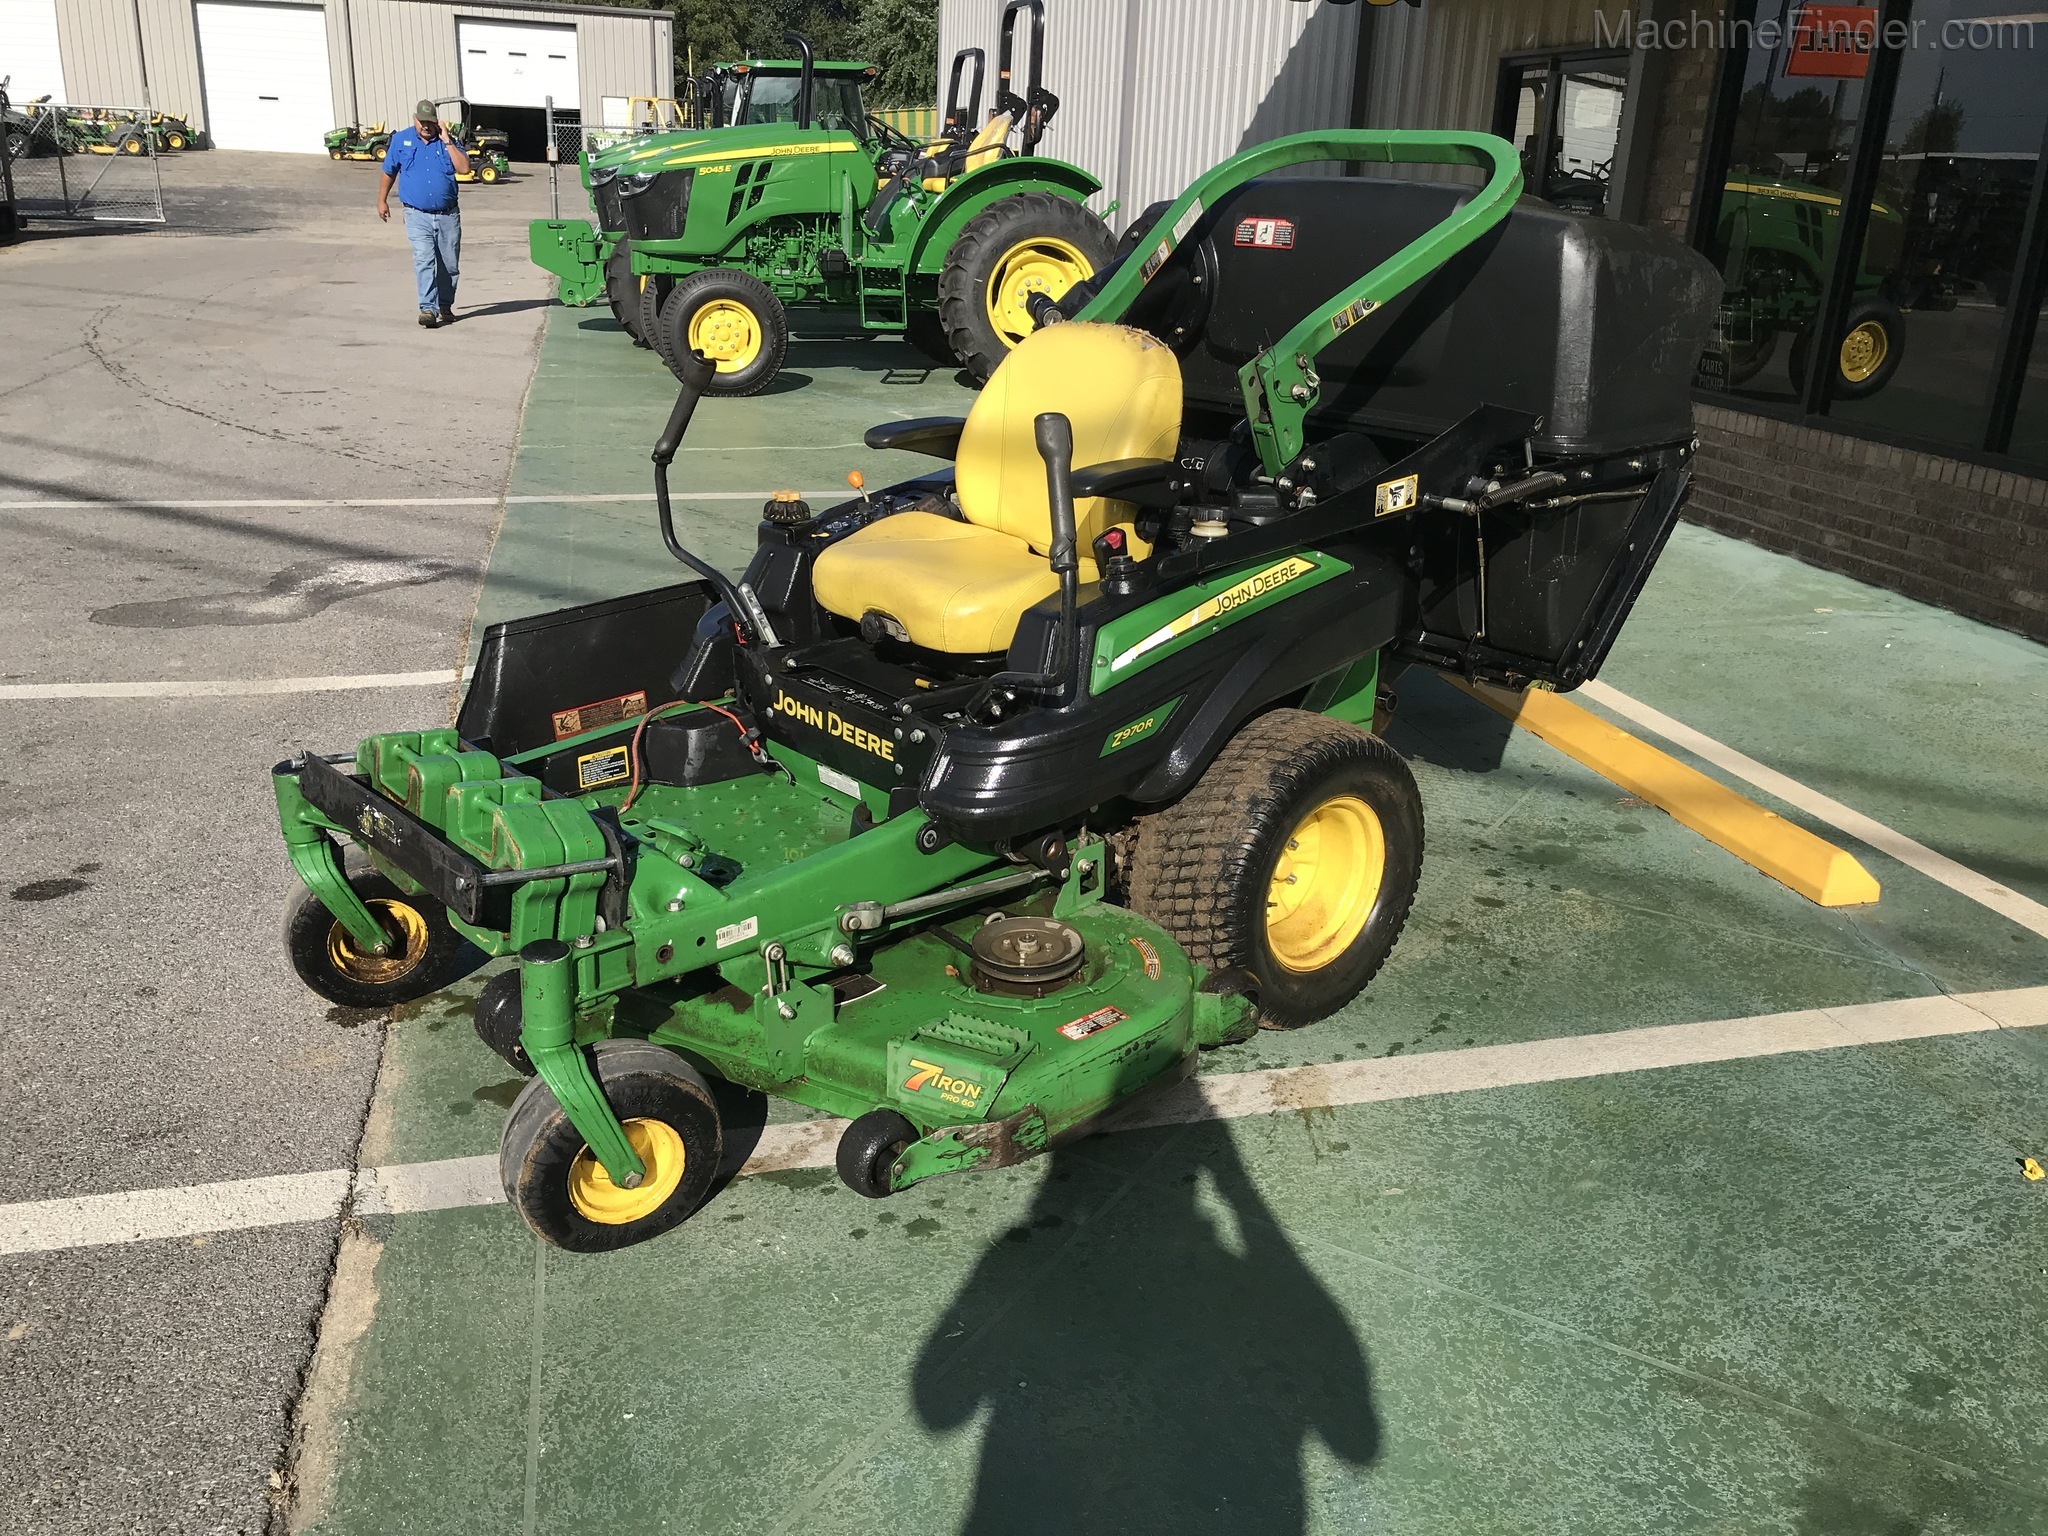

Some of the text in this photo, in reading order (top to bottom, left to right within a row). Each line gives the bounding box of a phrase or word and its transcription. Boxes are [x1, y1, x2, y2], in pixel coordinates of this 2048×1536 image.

[771, 147, 793, 155] JOHN
[699, 164, 732, 176] 5045 E
[1701, 358, 1723, 375] PARTS
[1214, 563, 1298, 615] JOHN DEERE
[773, 689, 823, 729] JOHN
[828, 711, 894, 762] DEERE
[1111, 717, 1154, 748] Z970R
[940, 1092, 975, 1108] PRO 60
